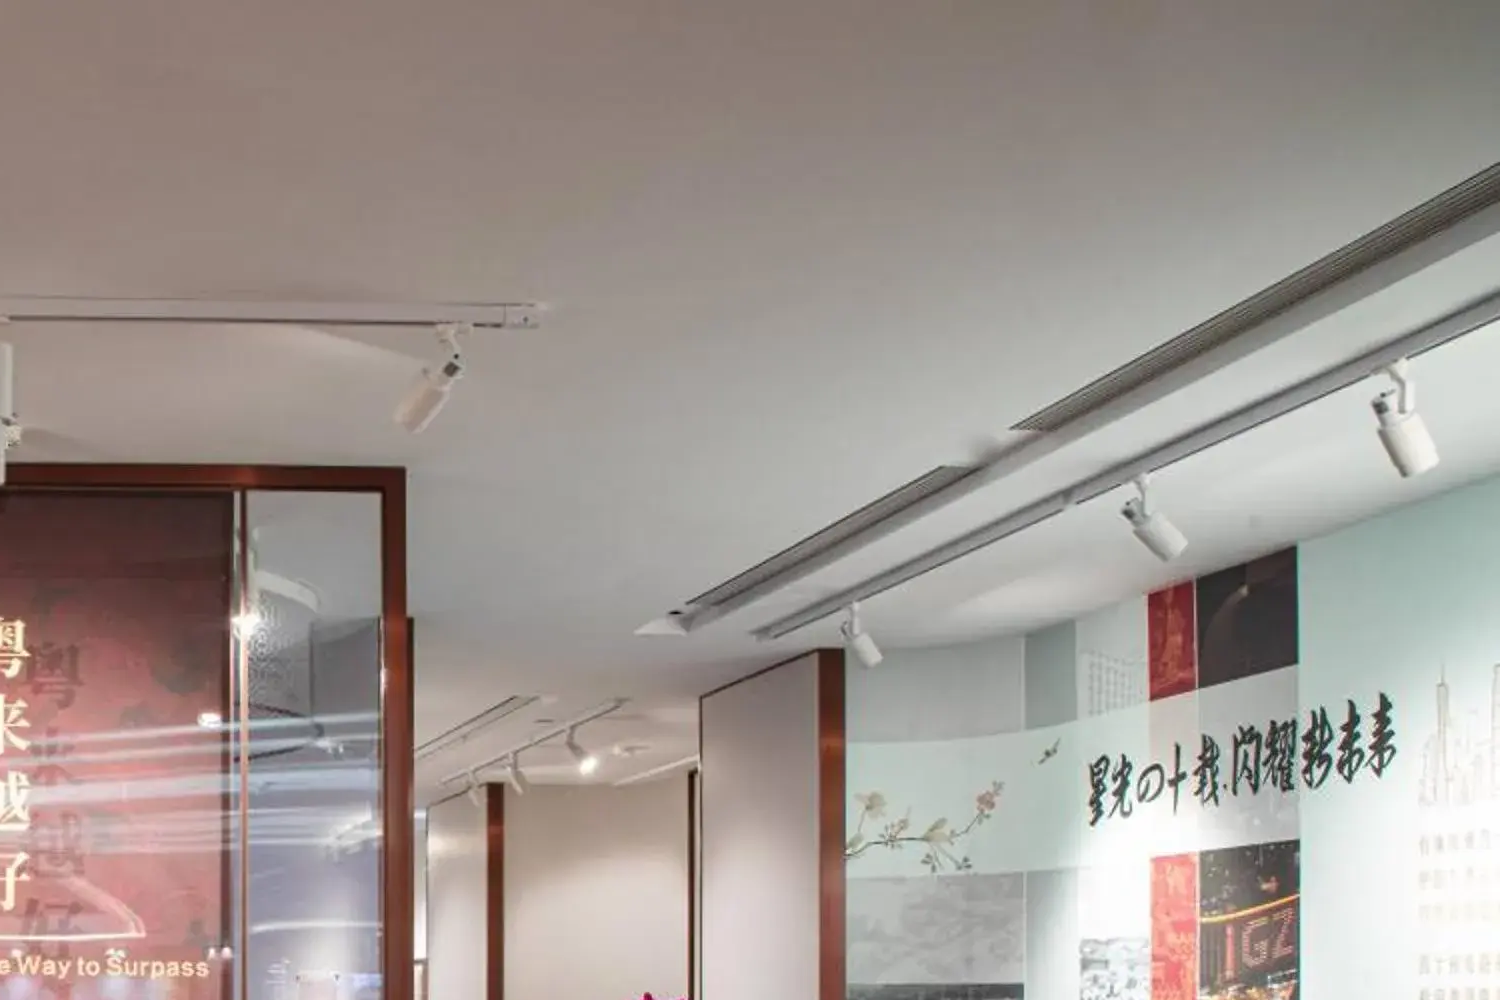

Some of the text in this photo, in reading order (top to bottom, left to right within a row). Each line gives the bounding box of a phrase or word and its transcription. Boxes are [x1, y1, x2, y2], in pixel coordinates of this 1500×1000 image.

[17, 955, 72, 980] Way
[77, 957, 101, 976] to
[106, 956, 211, 980] Surpass
